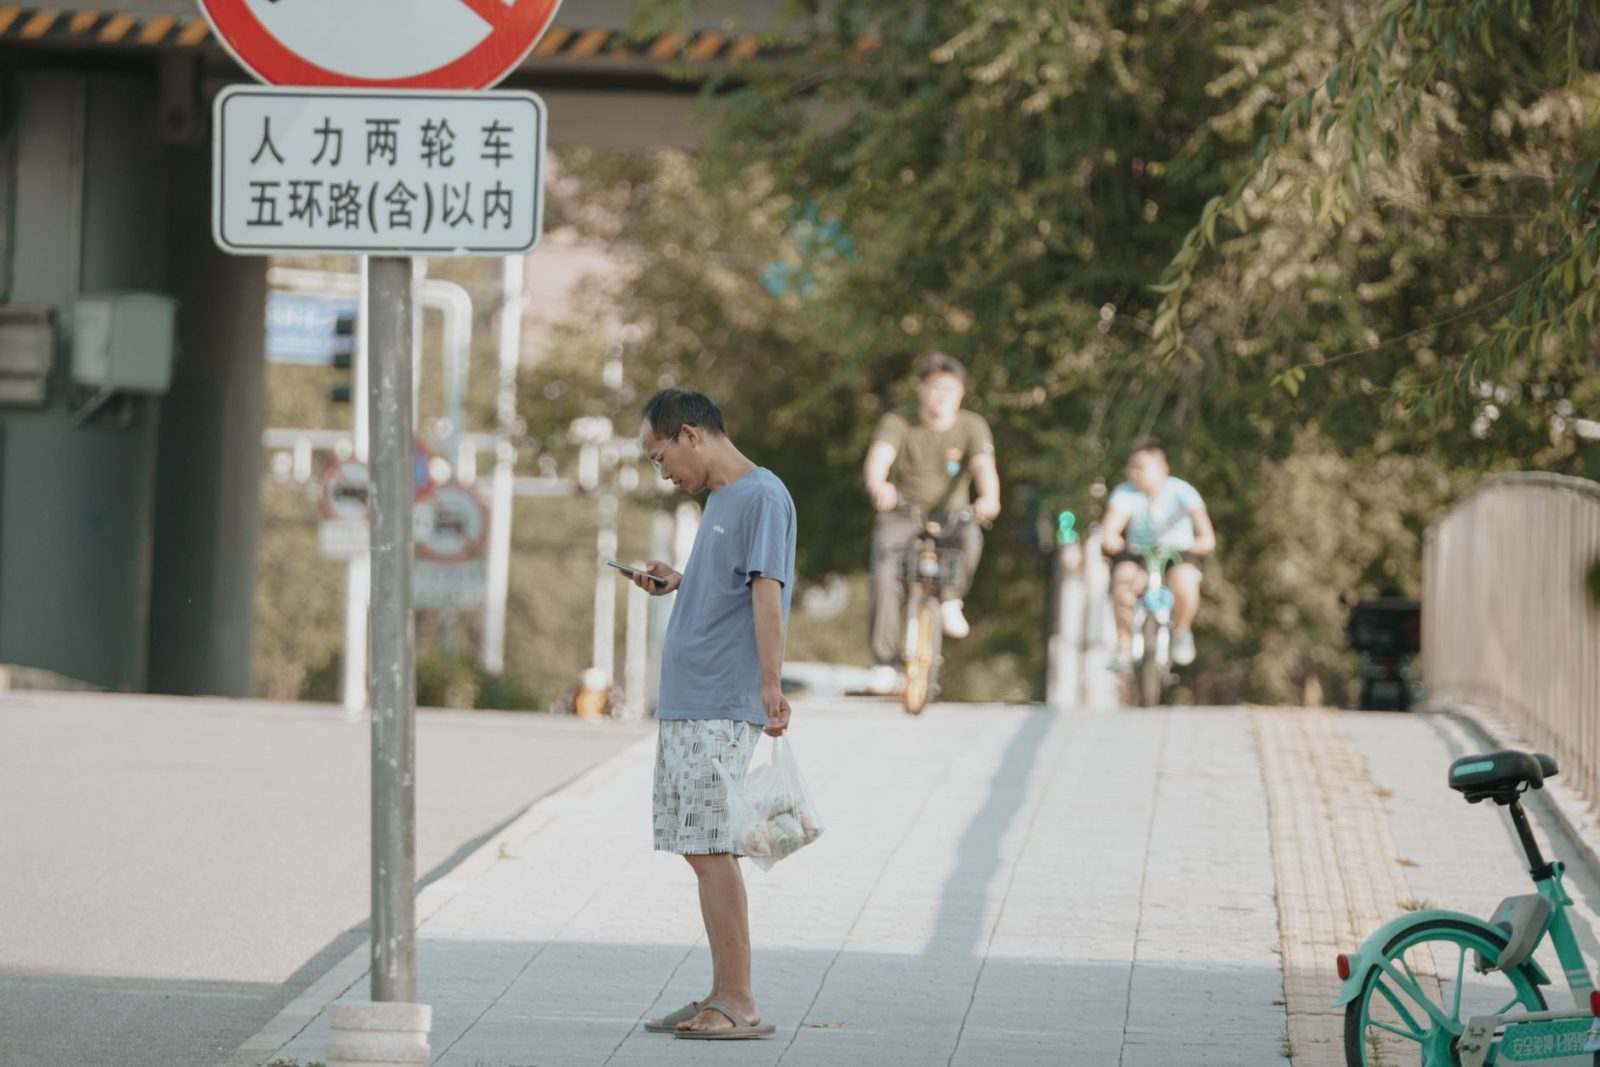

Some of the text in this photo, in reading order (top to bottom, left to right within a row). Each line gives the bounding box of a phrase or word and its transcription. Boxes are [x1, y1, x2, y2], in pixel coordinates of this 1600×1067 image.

[250, 116, 513, 168] 人力两轮车
[246, 179, 513, 234] 五环路(含)以内
